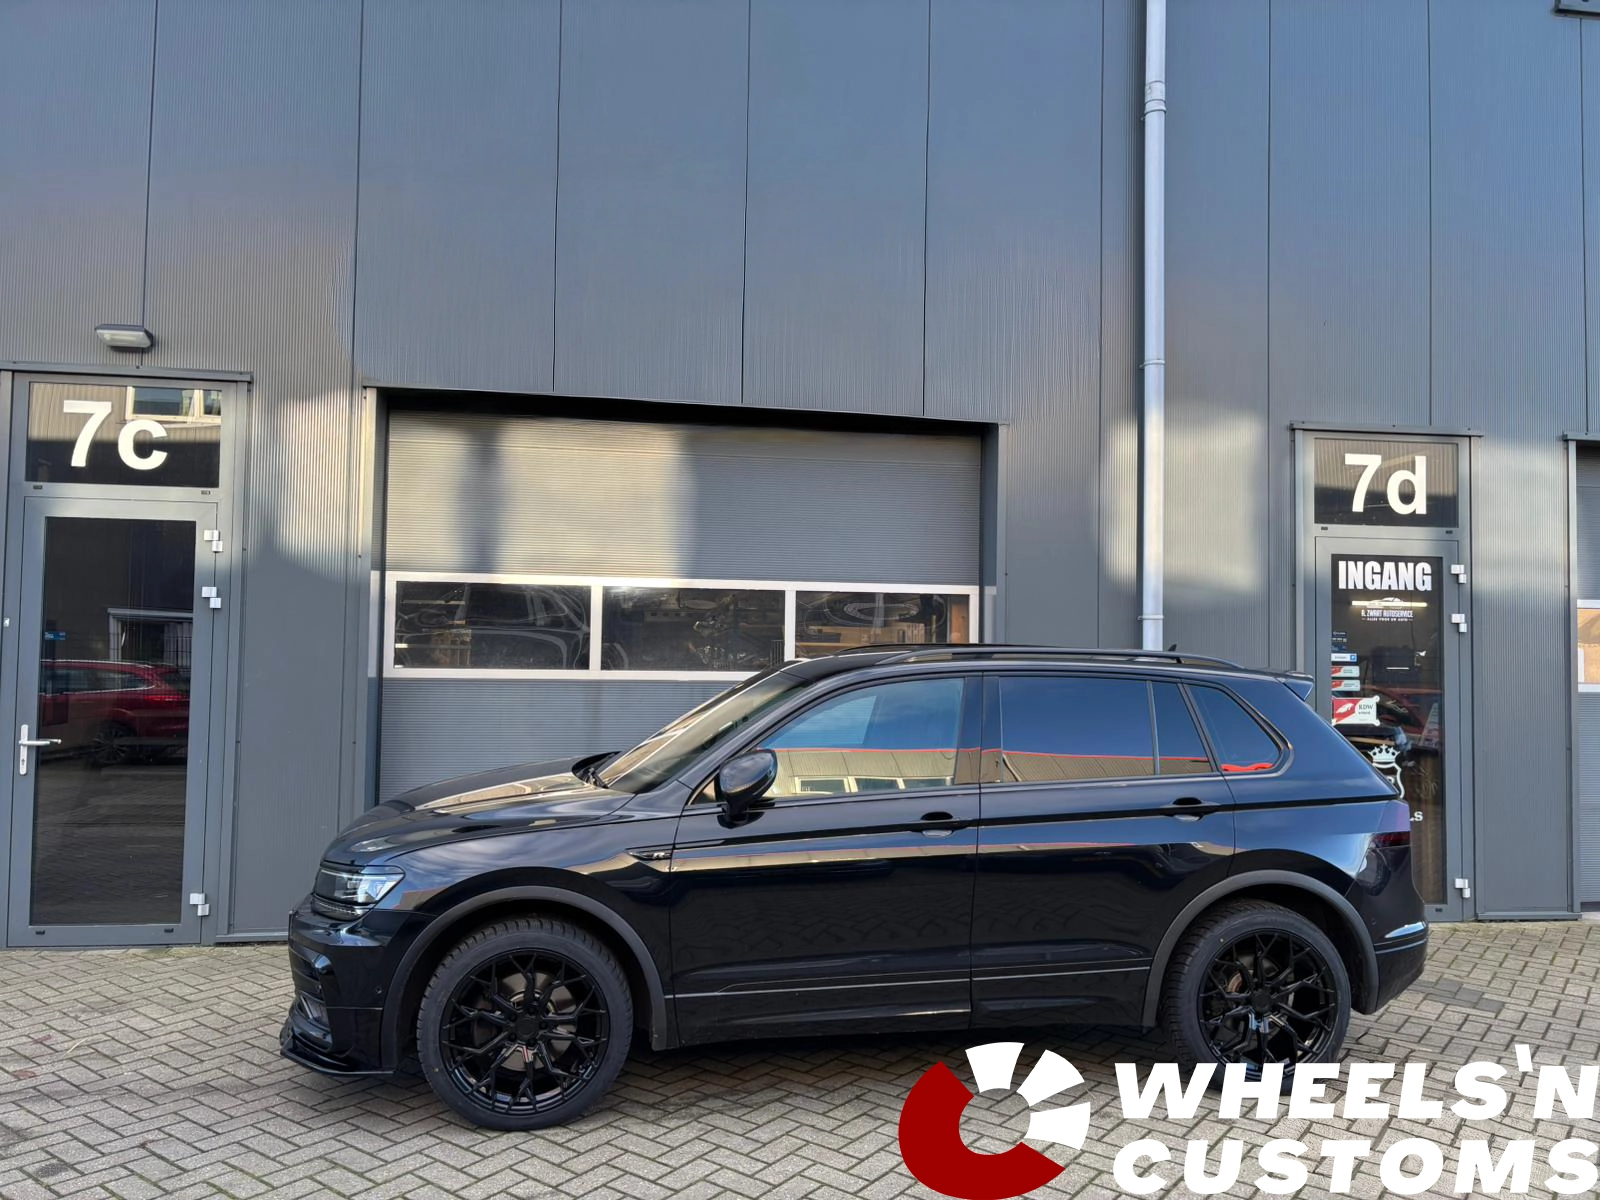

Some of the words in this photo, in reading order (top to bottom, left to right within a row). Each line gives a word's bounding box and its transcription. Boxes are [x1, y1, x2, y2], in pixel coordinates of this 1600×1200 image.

[63, 399, 168, 470] 7c
[1344, 453, 1427, 515] 7d
[1338, 560, 1432, 591] INGANG
[1383, 610, 1413, 618] AUTOSERVICE
